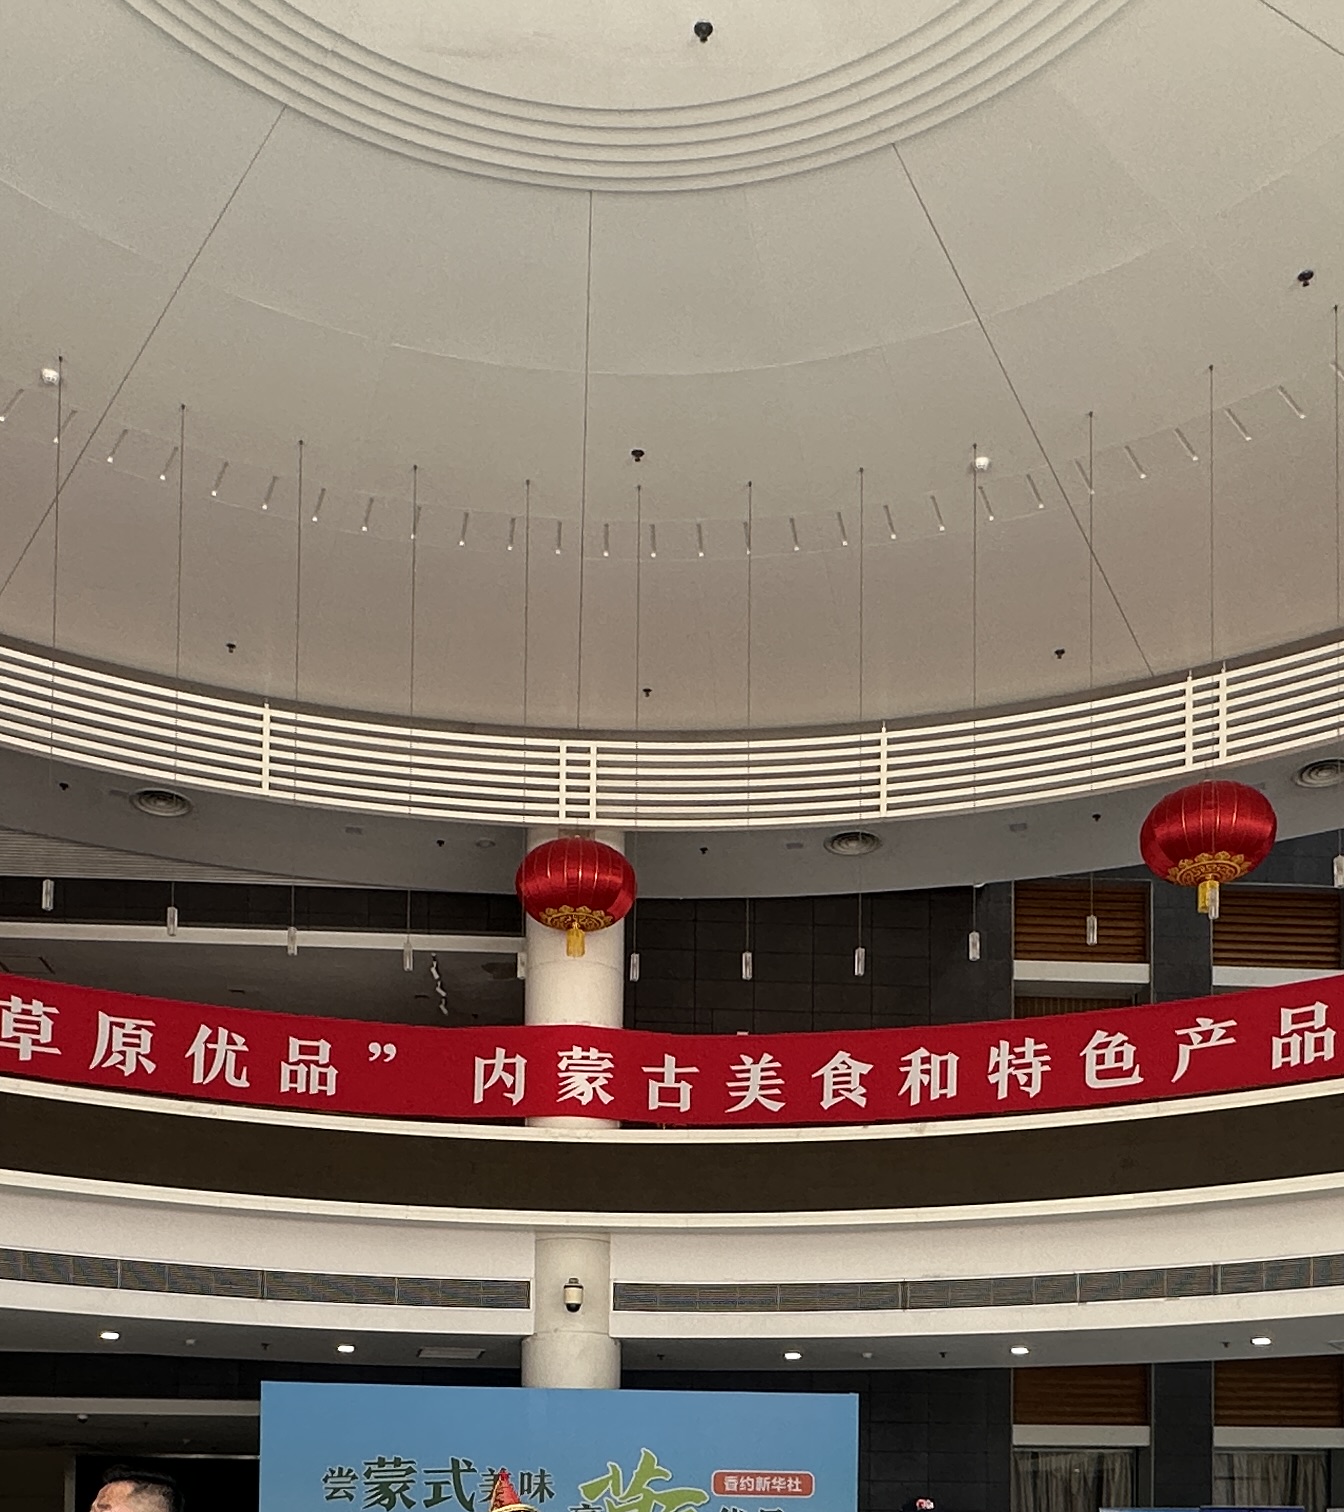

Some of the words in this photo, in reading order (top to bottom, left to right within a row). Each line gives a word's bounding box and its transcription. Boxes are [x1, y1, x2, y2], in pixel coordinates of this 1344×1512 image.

[723, 1475, 803, 1493] 香约新华社
